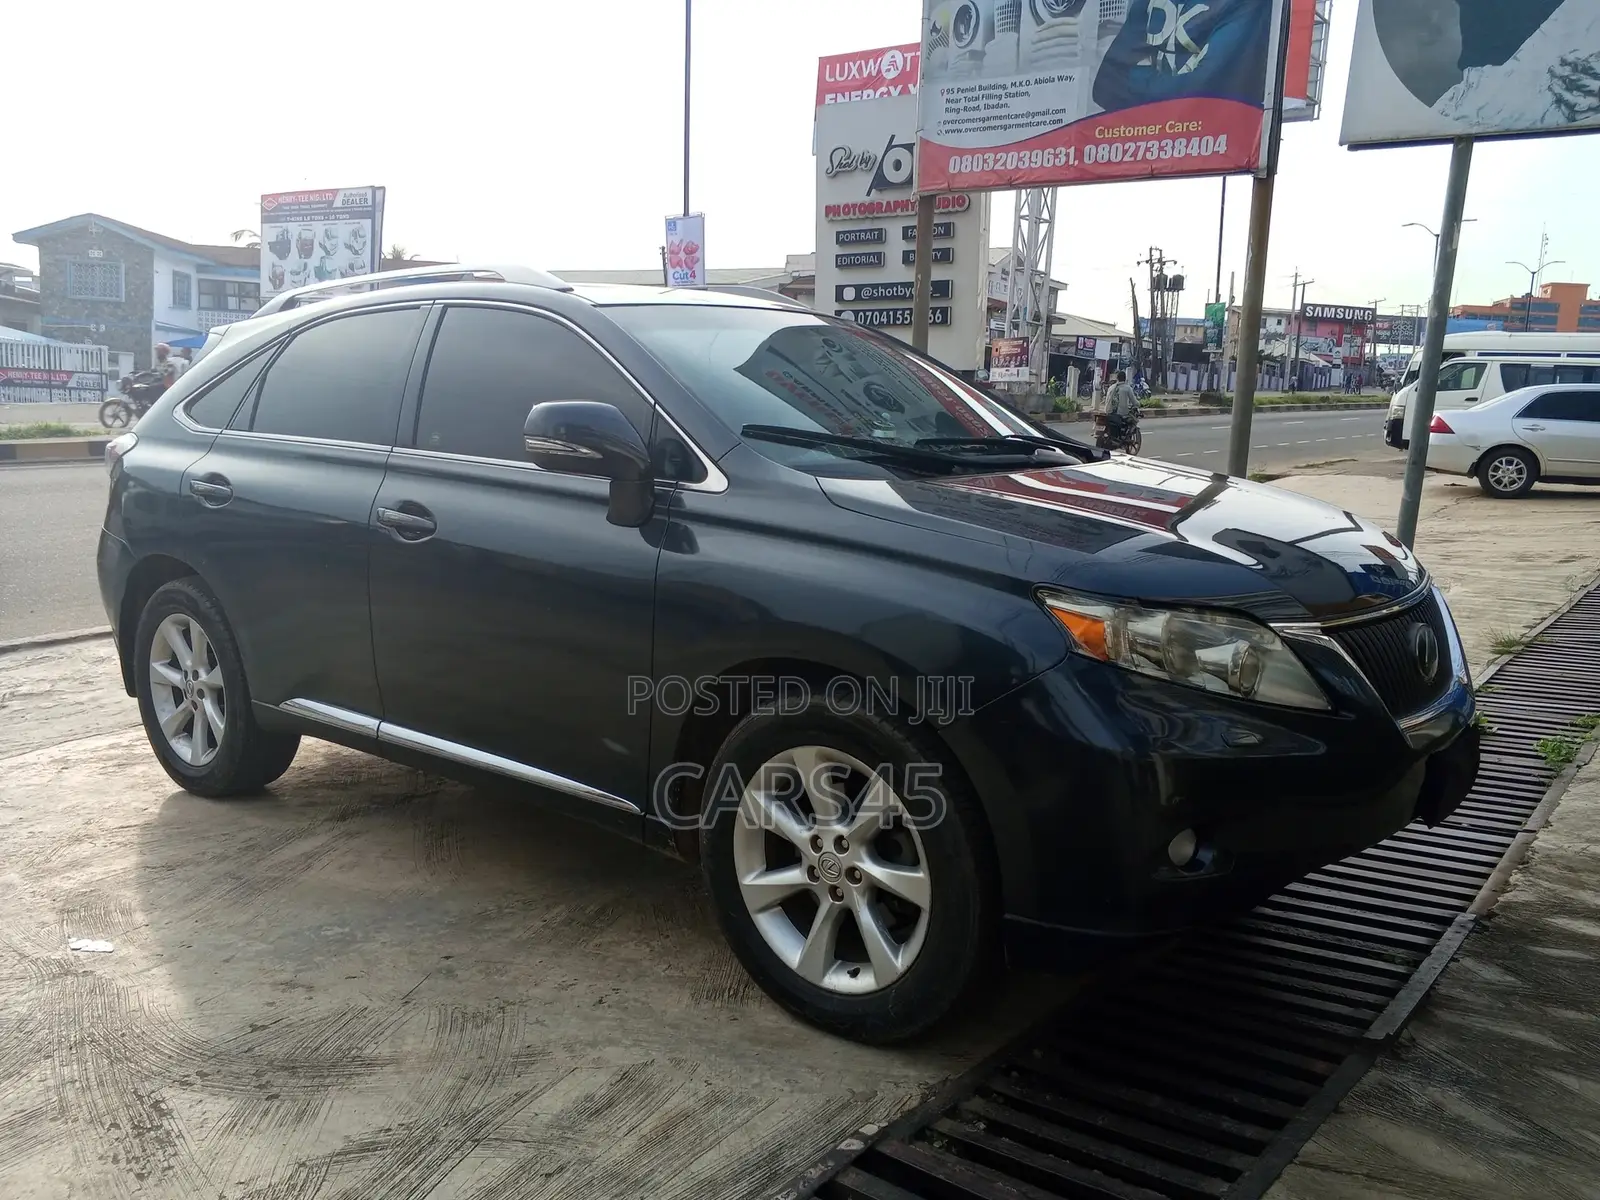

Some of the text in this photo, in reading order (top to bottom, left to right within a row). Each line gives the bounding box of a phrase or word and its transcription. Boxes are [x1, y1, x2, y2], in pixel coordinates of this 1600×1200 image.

[956, 86, 977, 94] Peniel
[978, 83, 1009, 92] Building,
[1010, 79, 1033, 88] M.K.O.
[1033, 76, 1056, 85] Abiola
[1057, 74, 1075, 83] Way,
[963, 95, 980, 103] Total
[981, 92, 1003, 101] Filling
[1004, 90, 1031, 99] Station,
[944, 102, 1010, 114] Ring-Road, Ibadan.
[942, 107, 1067, 126] overcomersgarmentcare@gmail.com
[944, 118, 1064, 135] www.overcomersgarmentcare.com
[1095, 120, 1202, 139] Customer Care:
[949, 134, 1228, 174] 08032039631, 08027338404
[341, 197, 369, 206] DEALER
[825, 199, 916, 218] PHOTOGRAPHY
[839, 226, 945, 242] PORTRAIT FAON
[837, 255, 879, 265] EDITORIAL
[857, 309, 942, 325] 070415566
[1305, 305, 1373, 321] SAMSUNG
